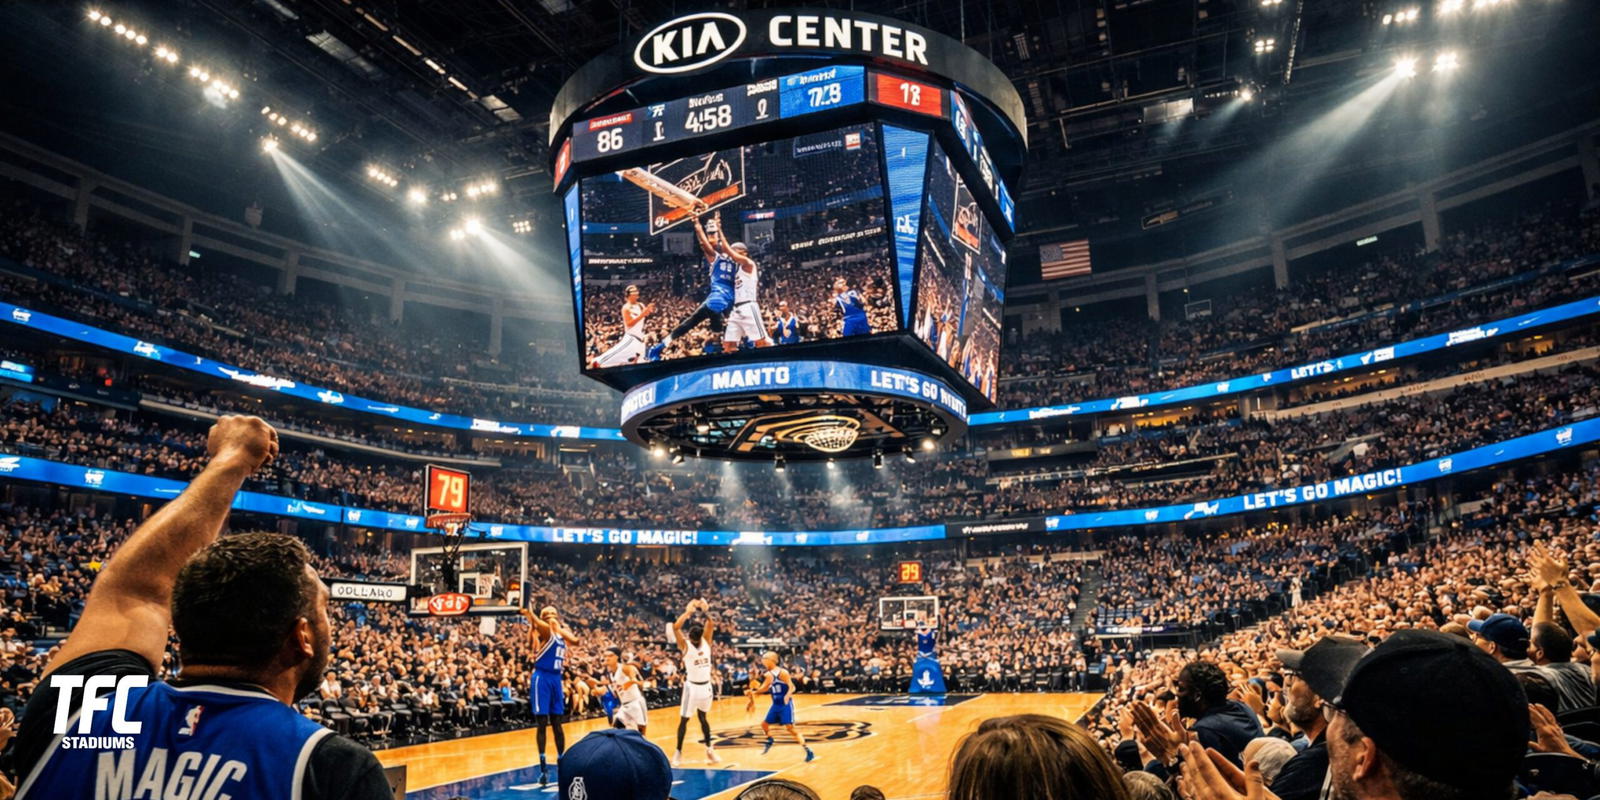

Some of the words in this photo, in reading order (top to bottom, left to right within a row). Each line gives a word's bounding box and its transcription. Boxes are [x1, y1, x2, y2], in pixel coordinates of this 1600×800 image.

[653, 21, 726, 66] KIA
[769, 15, 928, 65] CENTER
[597, 127, 624, 152] 86
[438, 473, 464, 508] 79
[1243, 489, 1297, 510] LET'S
[1302, 484, 1328, 500] GO
[1334, 469, 1402, 495] MAGIC!
[552, 528, 604, 543] LET'S
[608, 530, 632, 544] GO
[637, 530, 698, 545] MAGIC!
[95, 747, 248, 800] MAGIC
